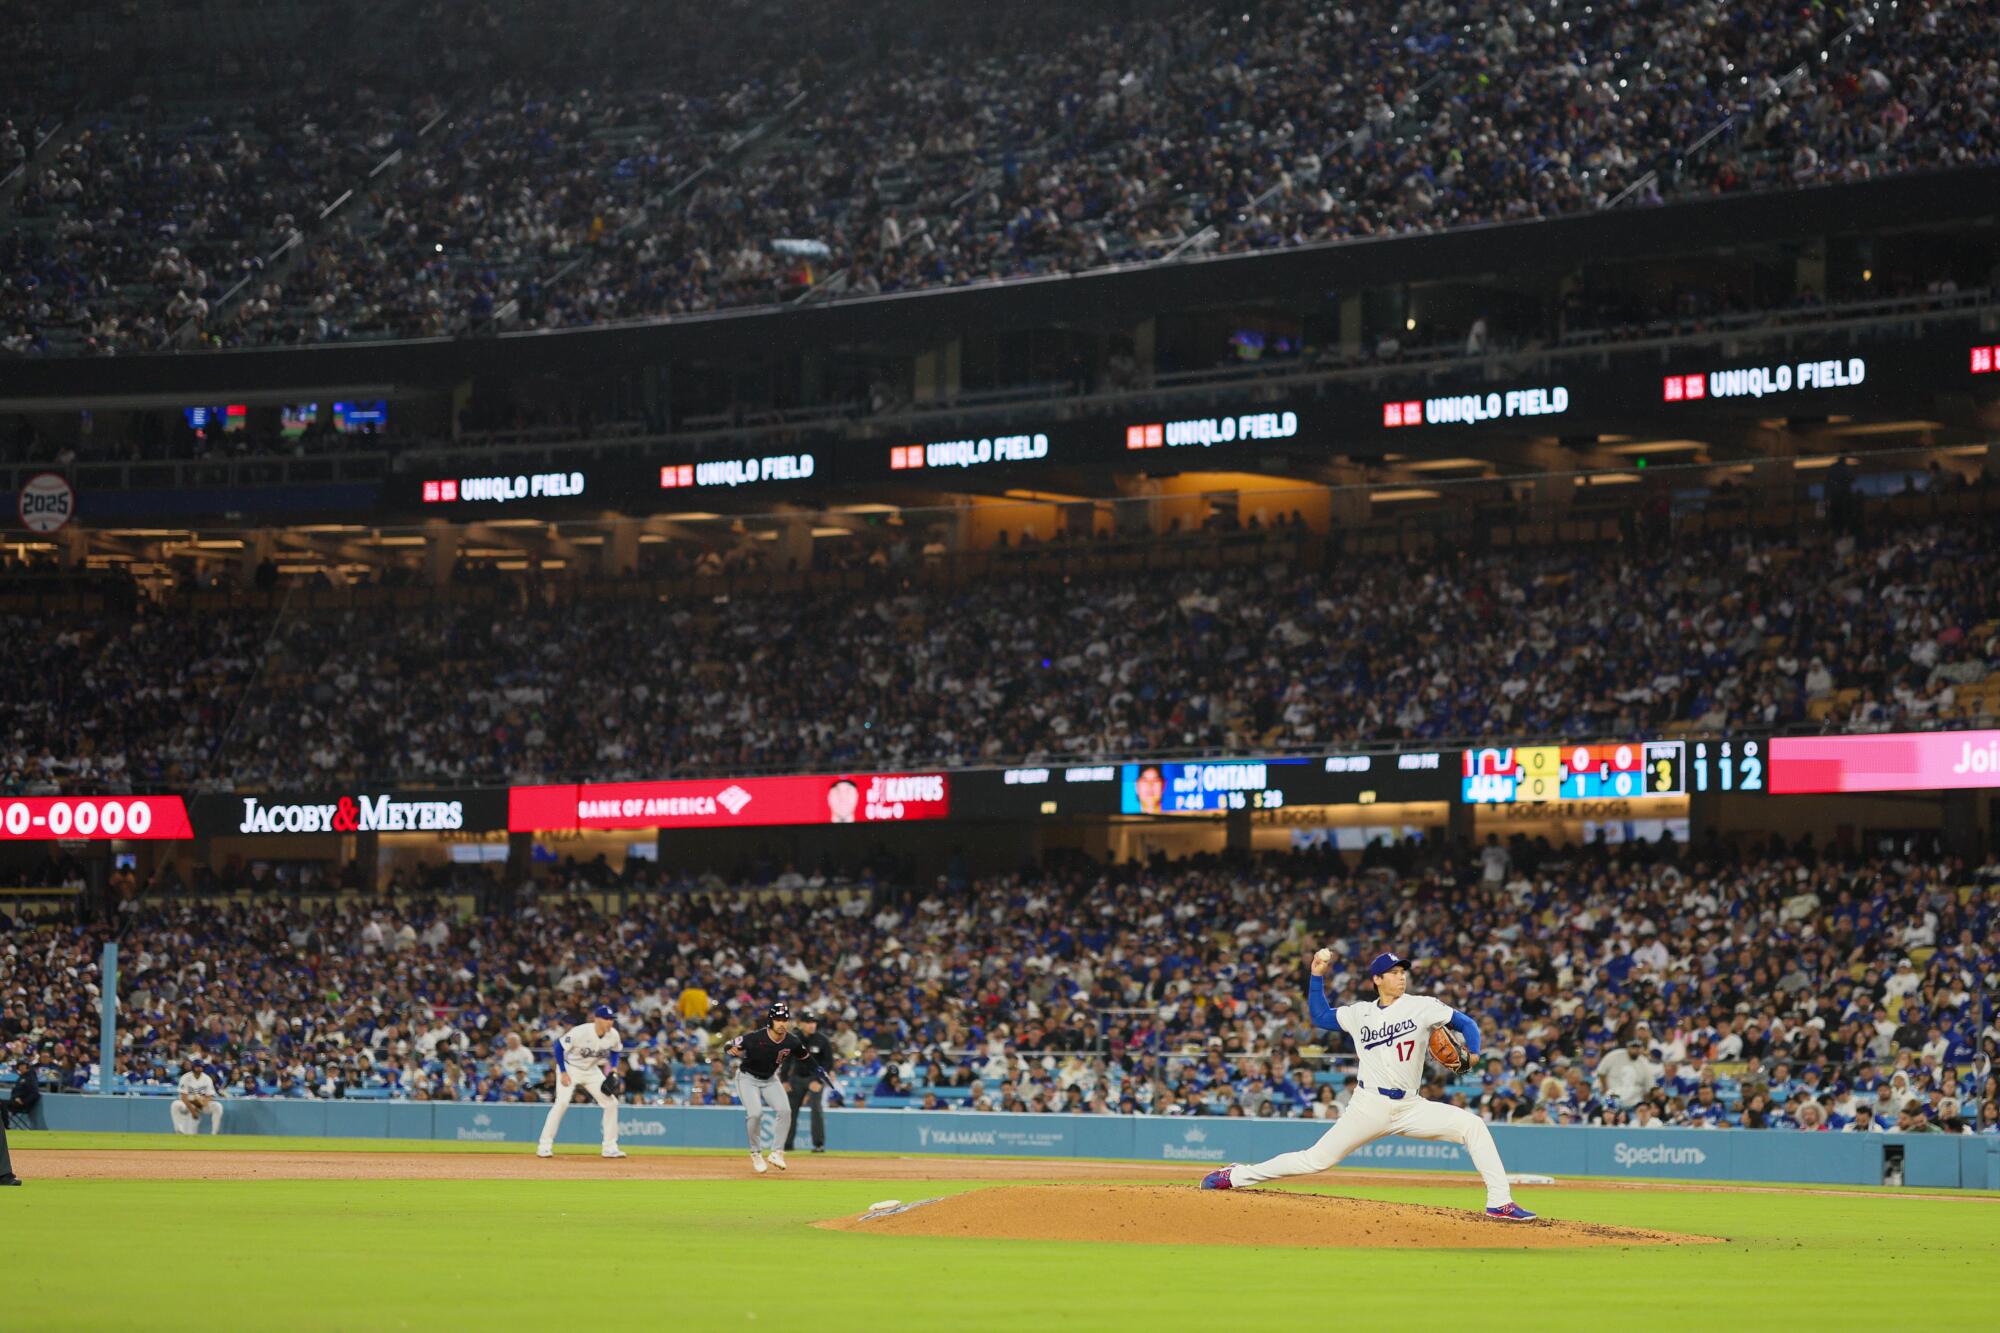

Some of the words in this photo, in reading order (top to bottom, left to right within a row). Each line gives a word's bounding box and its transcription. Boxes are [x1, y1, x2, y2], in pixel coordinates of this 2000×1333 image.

[1710, 365, 1792, 398] UNIQLO
[1797, 358, 1865, 390] FIELD
[1426, 392, 1501, 424] UNIQLO
[1506, 387, 1568, 417] FIELD
[1166, 417, 1236, 447] UNIQLO
[1239, 411, 1297, 440] FIELD
[927, 438, 991, 467] UNIQLO
[994, 433, 1048, 461] FIELD
[696, 458, 759, 487] UNIQLO
[762, 454, 814, 480] FIELD
[461, 475, 528, 502] UNIQLO
[531, 472, 584, 498] FIELD
[23, 492, 69, 515] 2025
[1572, 747, 1589, 771] 0
[1615, 745, 1632, 770] 0
[1743, 740, 1758, 757] O
[1952, 740, 2000, 773] Joi
[1203, 764, 1267, 791] OHTANI
[1575, 774, 1586, 797] 1
[1615, 772, 1632, 796] 0
[1656, 759, 1672, 792] 3
[1694, 758, 1707, 791] 1
[1719, 757, 1732, 790] 1
[1739, 756, 1762, 790] 2
[0, 801, 152, 835] 0-0000
[578, 800, 621, 819] BANK
[622, 799, 644, 817] OF
[644, 796, 717, 817] AMERICA
[1582, 802, 1630, 816] DOGS
[1360, 1018, 1417, 1046] Dodgers
[1396, 1040, 1415, 1062] 17
[602, 1117, 662, 1136] ectrum
[1375, 1145, 1393, 1157] OF
[1396, 1146, 1460, 1160] AMERICA
[1614, 1141, 1699, 1168] Spectrum
